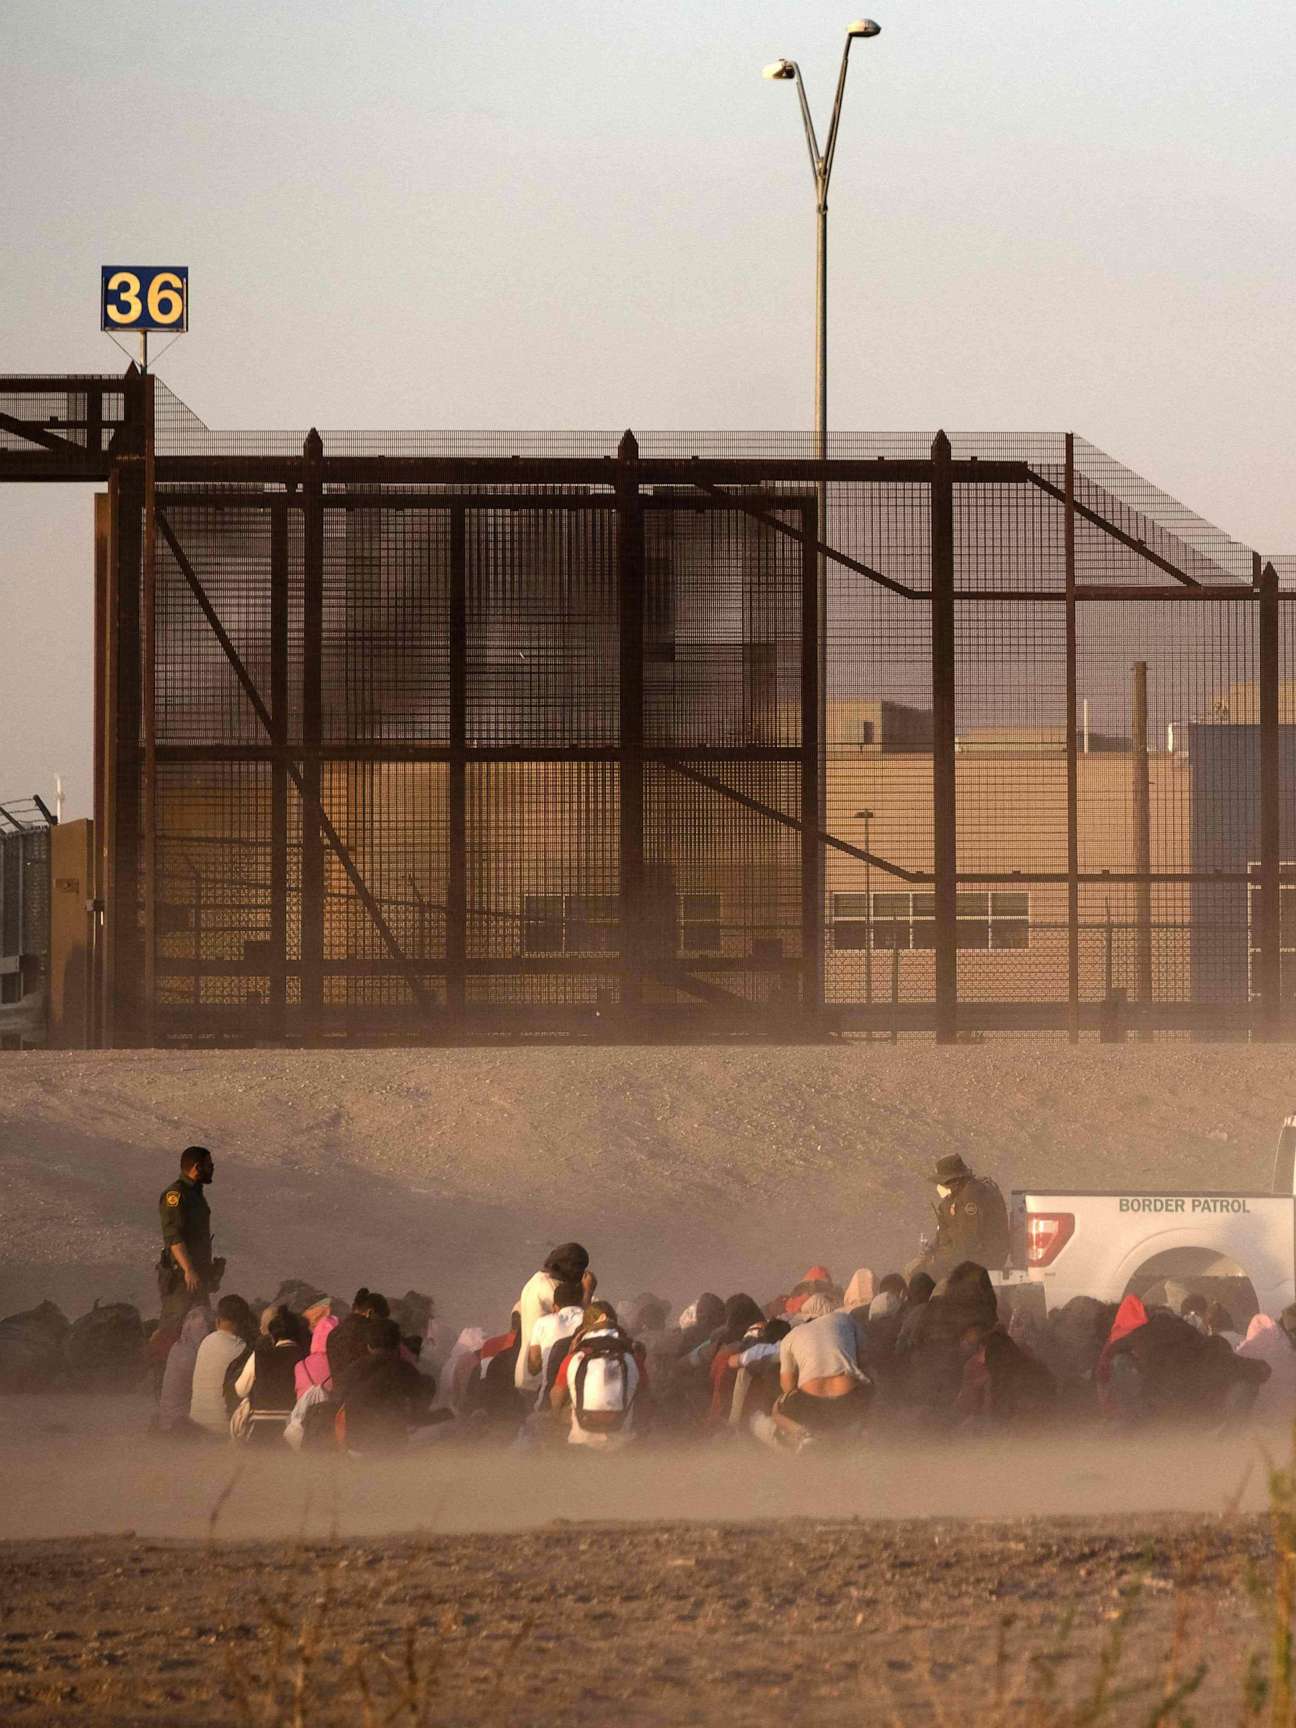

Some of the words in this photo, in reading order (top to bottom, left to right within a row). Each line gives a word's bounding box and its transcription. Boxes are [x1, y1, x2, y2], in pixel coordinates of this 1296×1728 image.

[106, 271, 183, 325] 36
[1119, 1198, 1185, 1213] BORDER
[1191, 1198, 1251, 1213] PATROL
